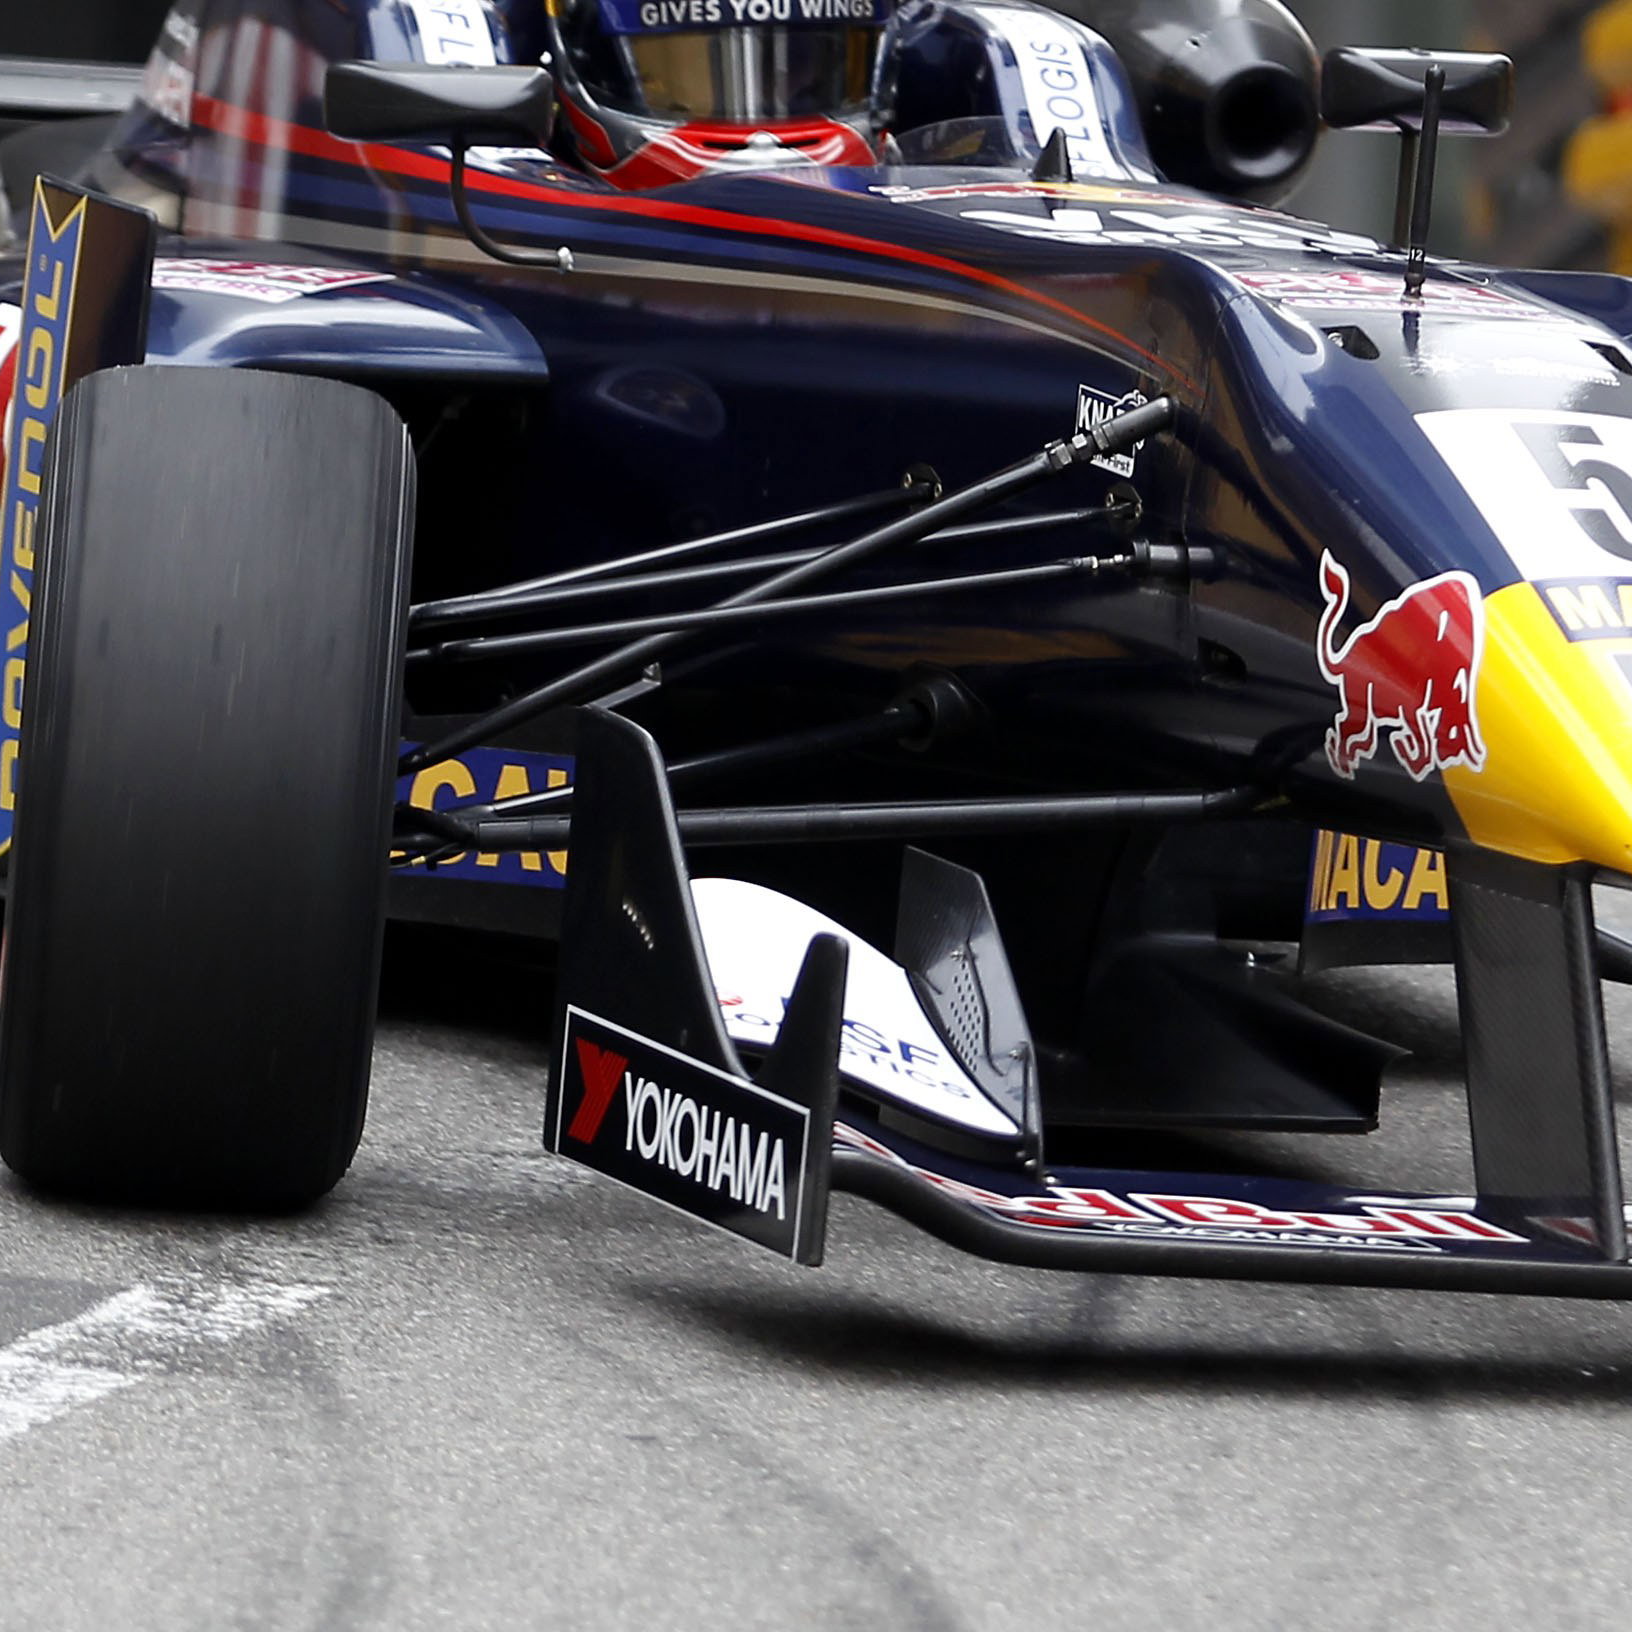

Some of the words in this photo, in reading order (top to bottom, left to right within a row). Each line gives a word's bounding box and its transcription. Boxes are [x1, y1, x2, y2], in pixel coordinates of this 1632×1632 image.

[640, 0, 721, 27] GIVES
[1410, 248, 1424, 262] 12
[1078, 394, 1126, 432] KNA
[1310, 828, 1450, 913] MACA
[624, 1070, 786, 1220] YOKOHAMA
[1126, 1192, 1531, 1243] Bull
